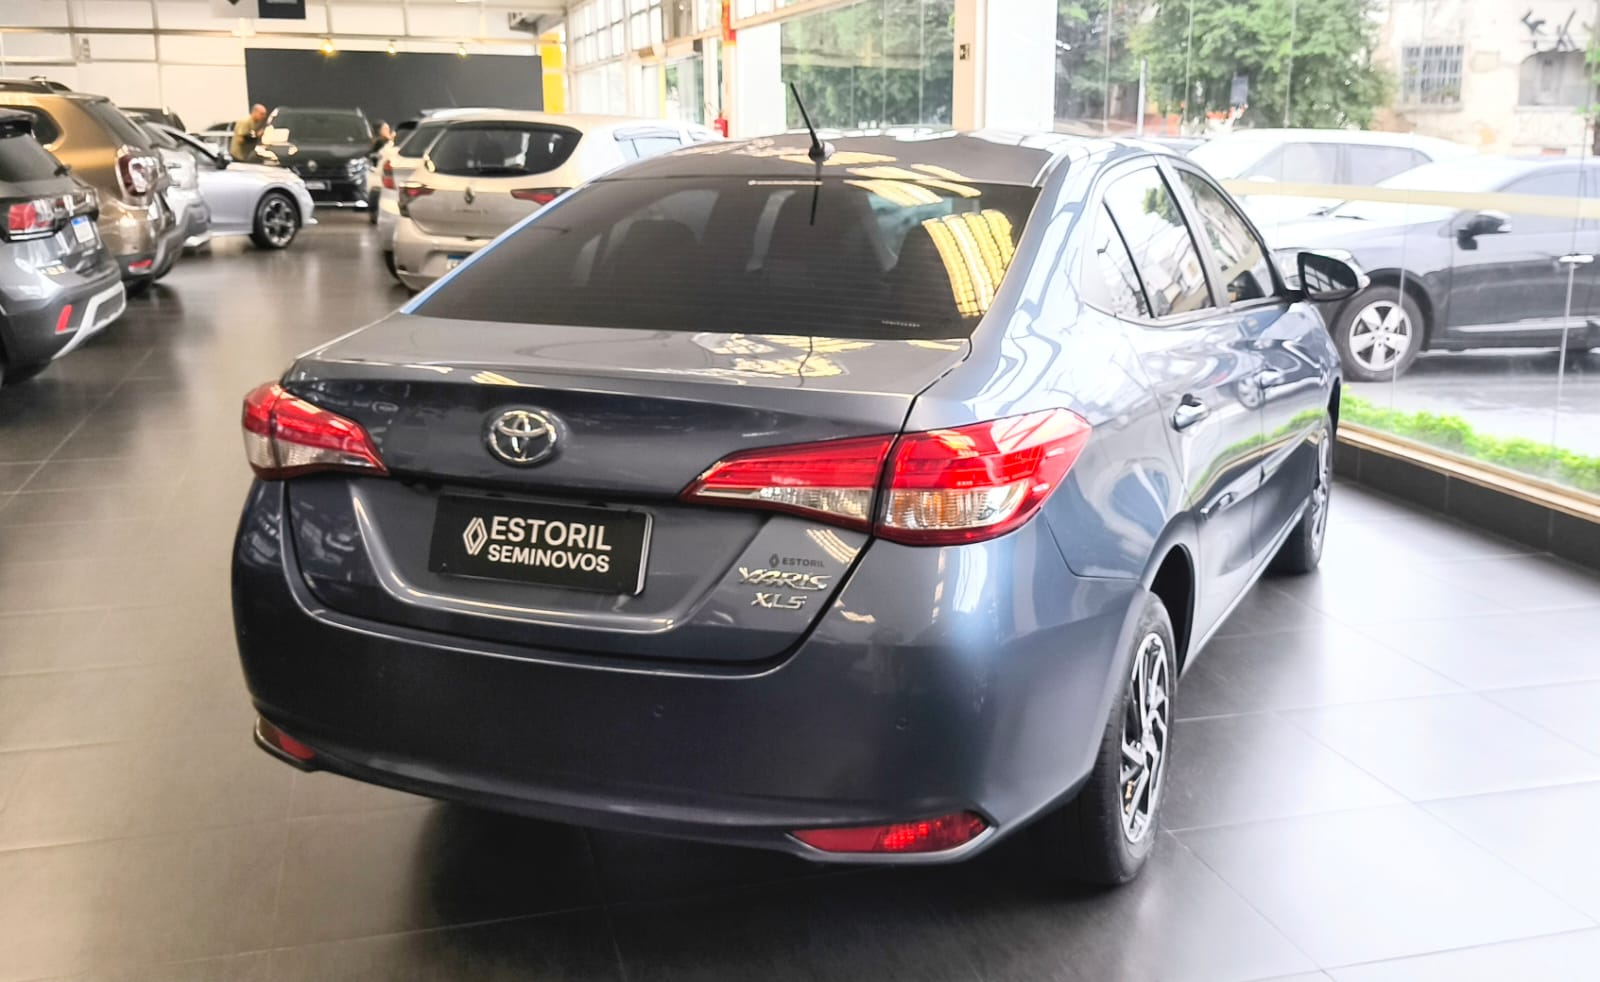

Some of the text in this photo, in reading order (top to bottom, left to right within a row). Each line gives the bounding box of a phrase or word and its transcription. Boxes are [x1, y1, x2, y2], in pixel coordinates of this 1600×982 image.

[490, 515, 612, 551] ESTORIL
[487, 544, 611, 573] SEMINOVOS
[782, 557, 825, 568] ESTORIL
[739, 567, 832, 590] YARIS
[751, 592, 807, 609] XLS
